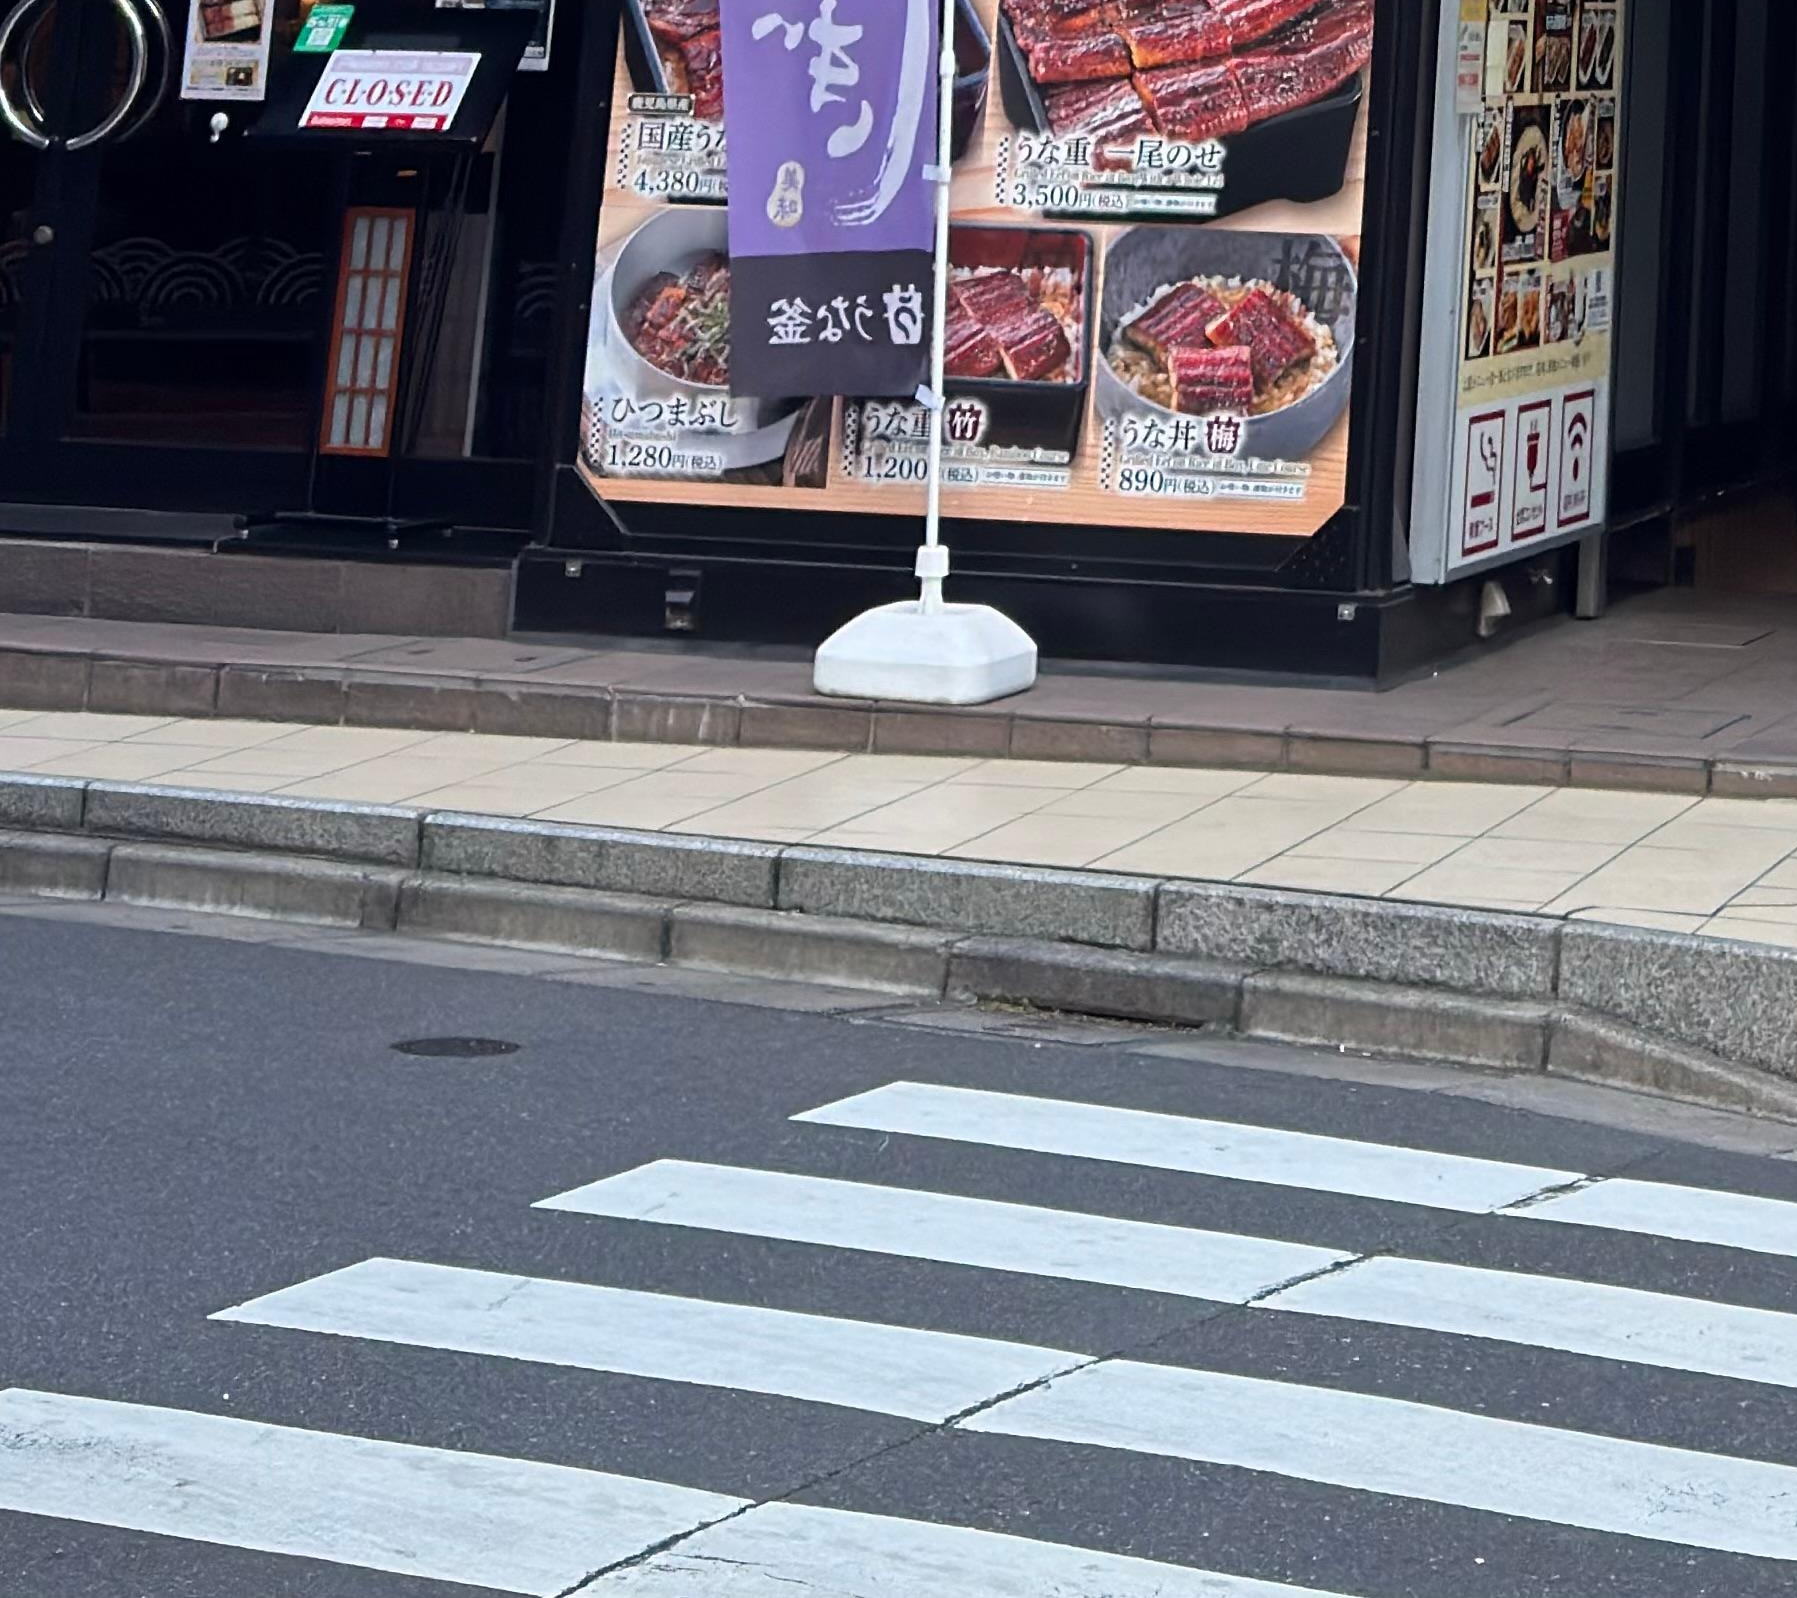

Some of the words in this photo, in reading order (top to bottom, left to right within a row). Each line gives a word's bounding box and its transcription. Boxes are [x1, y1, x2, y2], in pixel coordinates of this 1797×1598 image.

[1018, 135, 1092, 166] うな重
[1107, 139, 1223, 169] 一尾のせ
[1012, 182, 1128, 210] 3,500円(税込)
[610, 396, 738, 428] ひつまぶし
[951, 410, 977, 439] 竹
[1123, 418, 1197, 451] うな丼
[1209, 422, 1235, 451] 梅
[607, 444, 723, 470] 1,280円(税込)
[863, 456, 979, 482] 1,200(税込)
[1119, 468, 1215, 495] 890円(税込)
